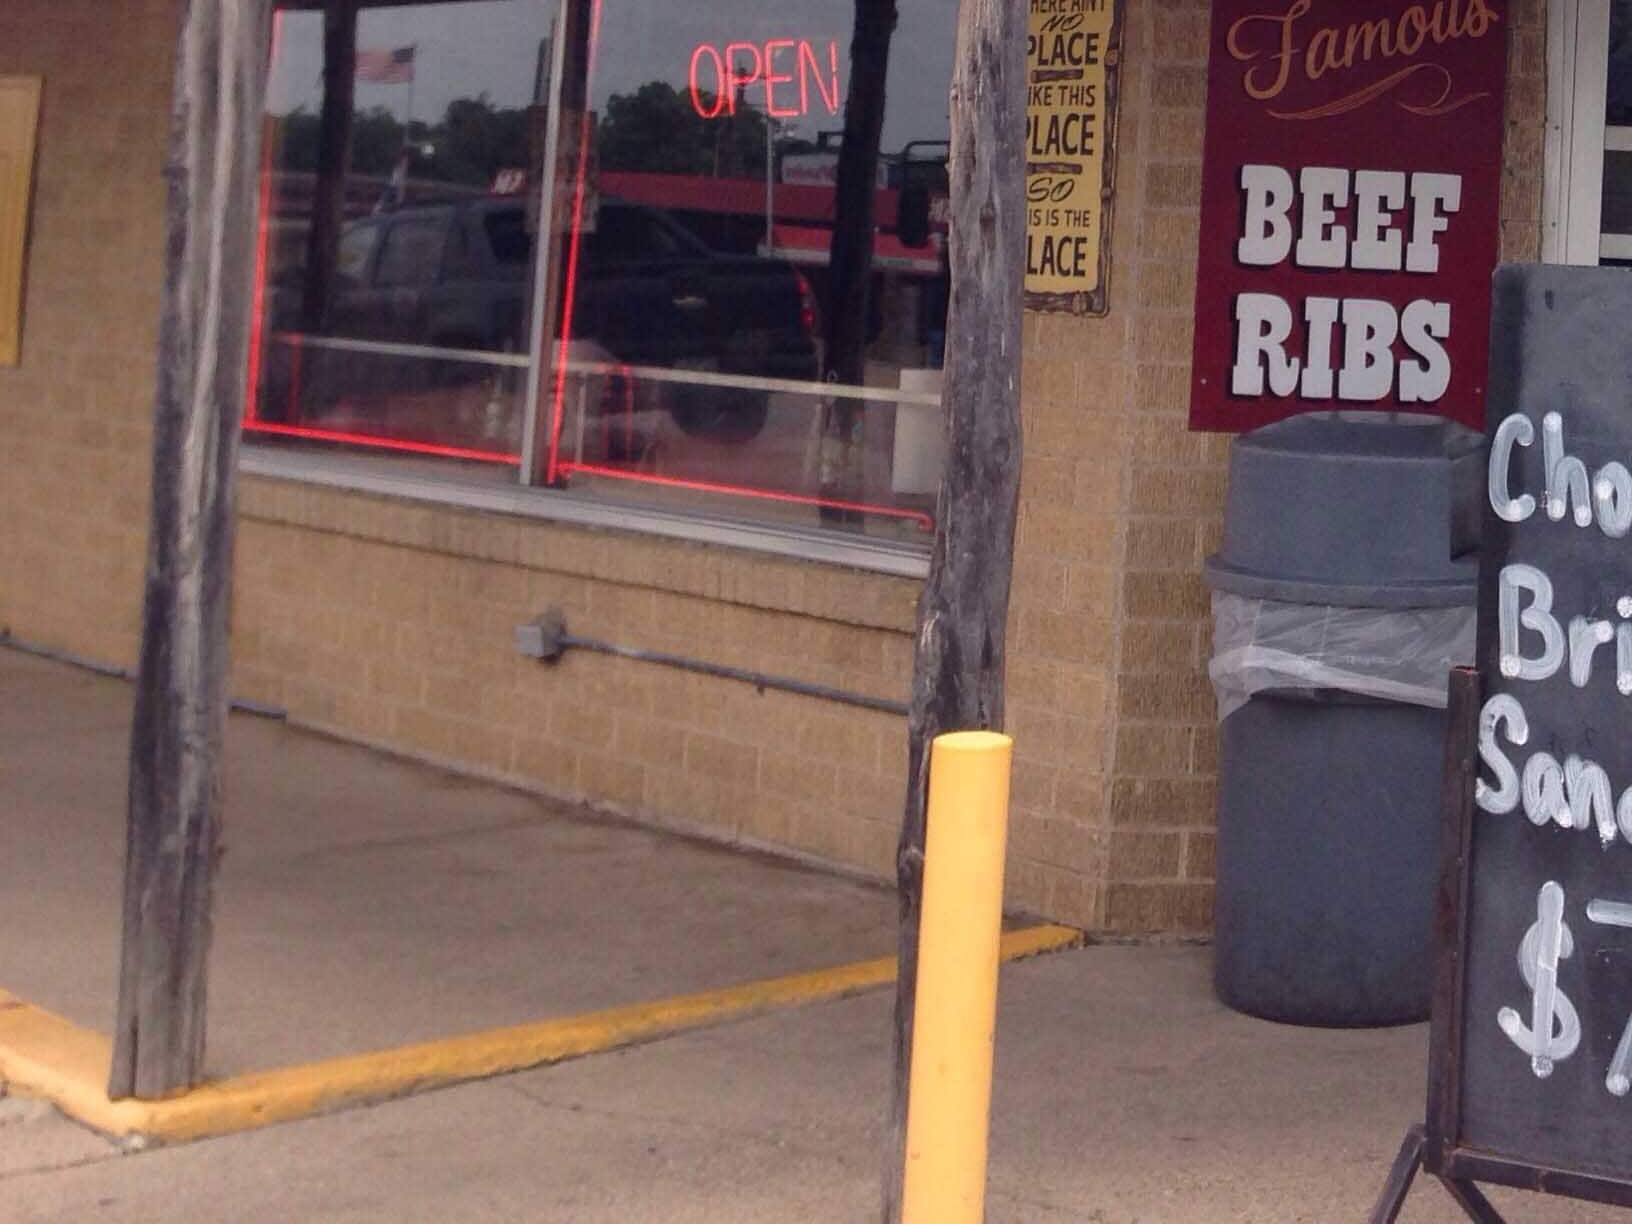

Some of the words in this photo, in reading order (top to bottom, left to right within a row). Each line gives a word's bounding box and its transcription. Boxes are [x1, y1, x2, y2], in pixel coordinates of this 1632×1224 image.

[1041, 13, 1085, 32] NO
[689, 38, 840, 119] OPEN
[1028, 86, 1053, 106] IKE
[1058, 85, 1096, 107] THIS
[1027, 113, 1094, 155] LACE
[1027, 177, 1075, 202] SO
[1029, 210, 1041, 226] IS
[1046, 209, 1059, 226] IS
[1065, 210, 1091, 227] THE
[1237, 164, 1461, 272] BEEF
[1027, 235, 1087, 277] LACE
[1231, 292, 1452, 402] RIBS
